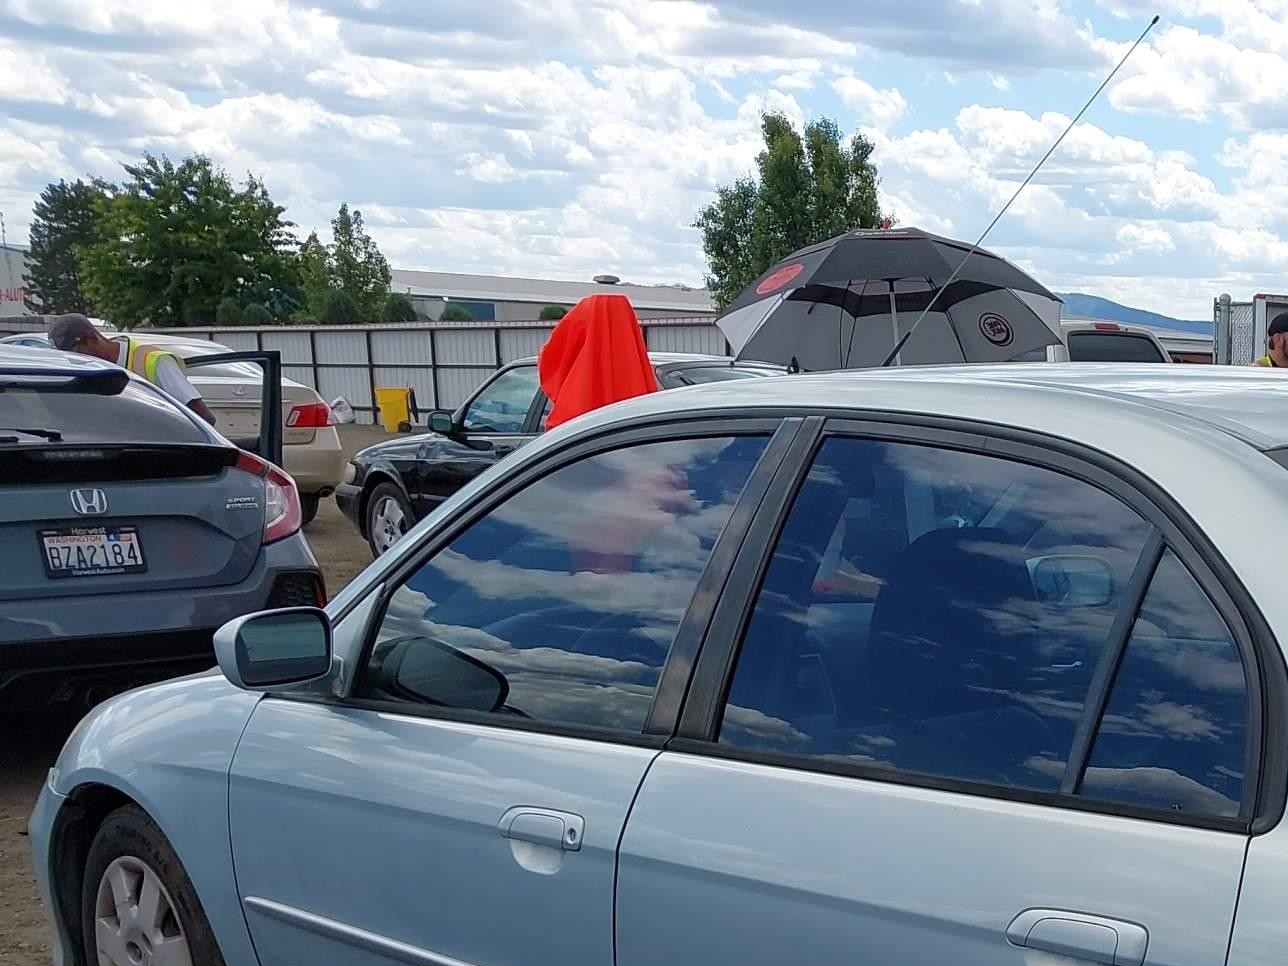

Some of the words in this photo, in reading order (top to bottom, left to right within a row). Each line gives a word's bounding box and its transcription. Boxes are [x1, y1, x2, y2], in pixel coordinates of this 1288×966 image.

[72, 527, 106, 535] Harvest
[48, 535, 102, 544] WASHINGTON
[48, 543, 139, 569] BZA2184
